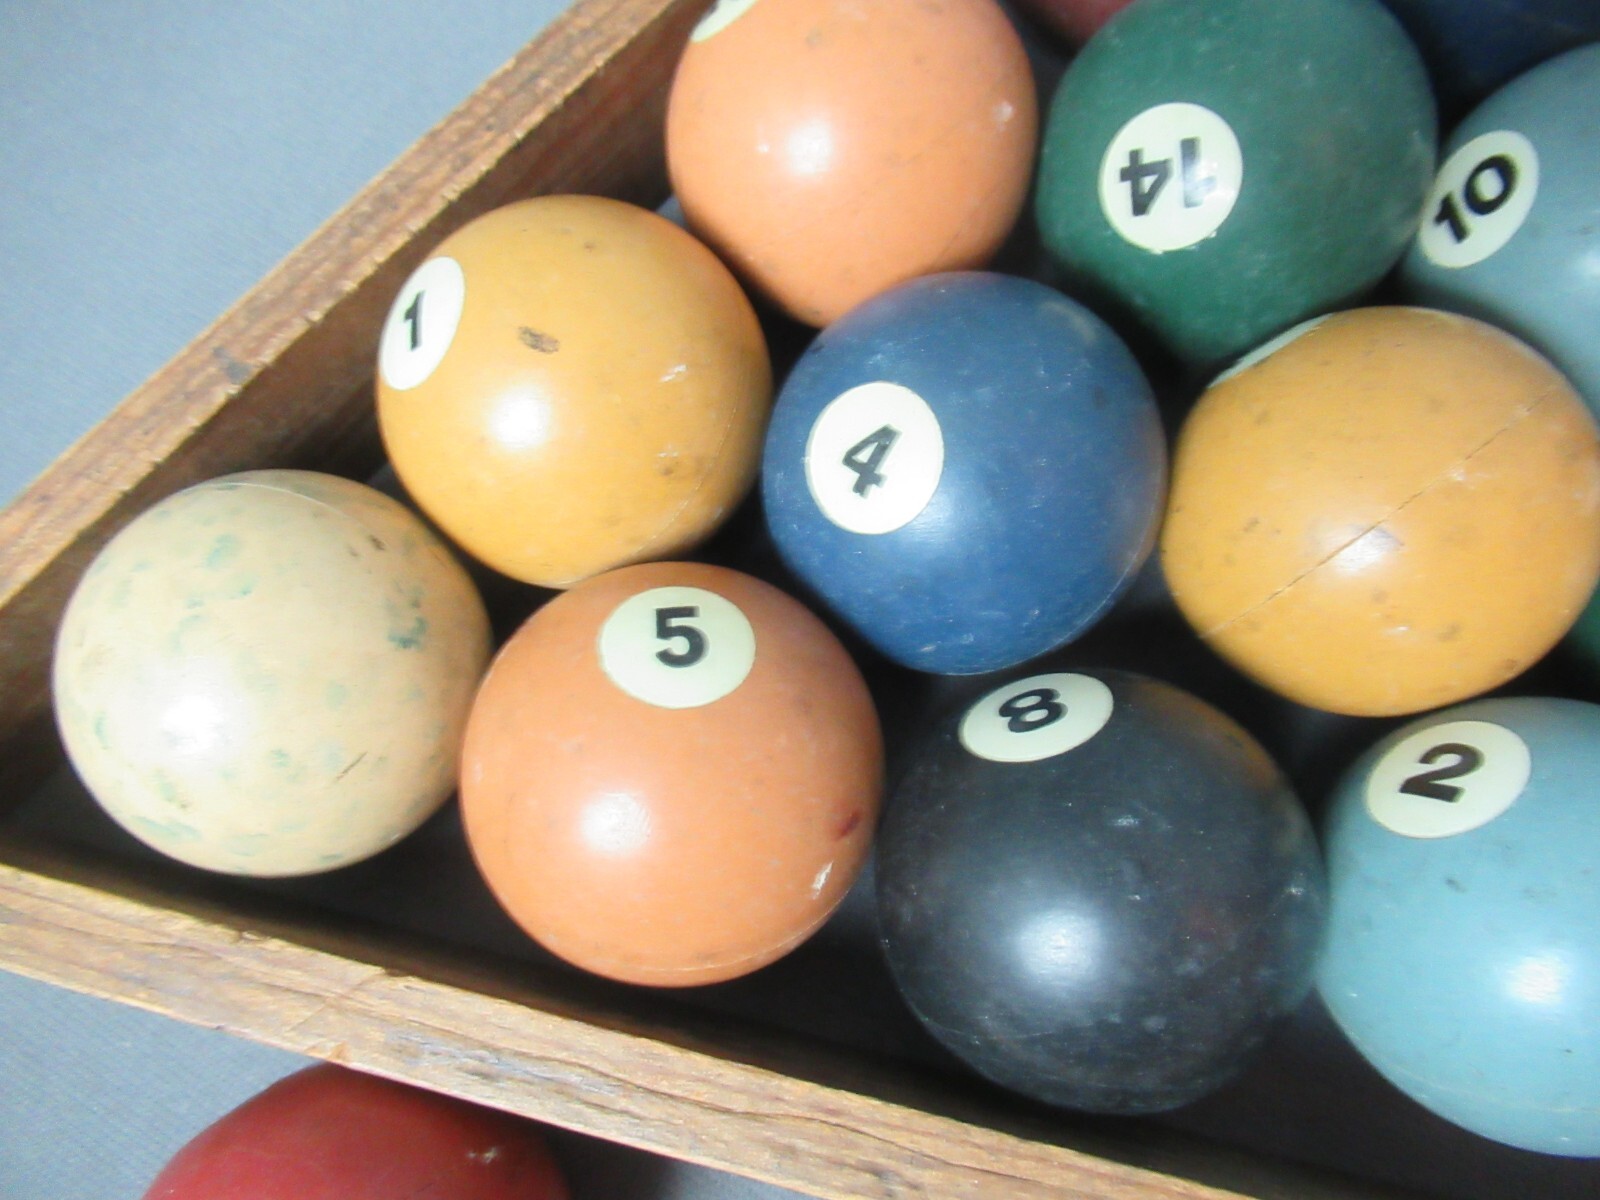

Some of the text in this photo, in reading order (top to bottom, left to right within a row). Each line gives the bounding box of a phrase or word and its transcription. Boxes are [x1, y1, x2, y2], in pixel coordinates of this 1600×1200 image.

[1117, 137, 1213, 217] 14
[1431, 153, 1519, 244] 10
[402, 290, 423, 352] 1
[841, 423, 899, 499] 4
[654, 605, 708, 668] 5
[996, 686, 1069, 734] 8
[1397, 742, 1484, 804] 2
